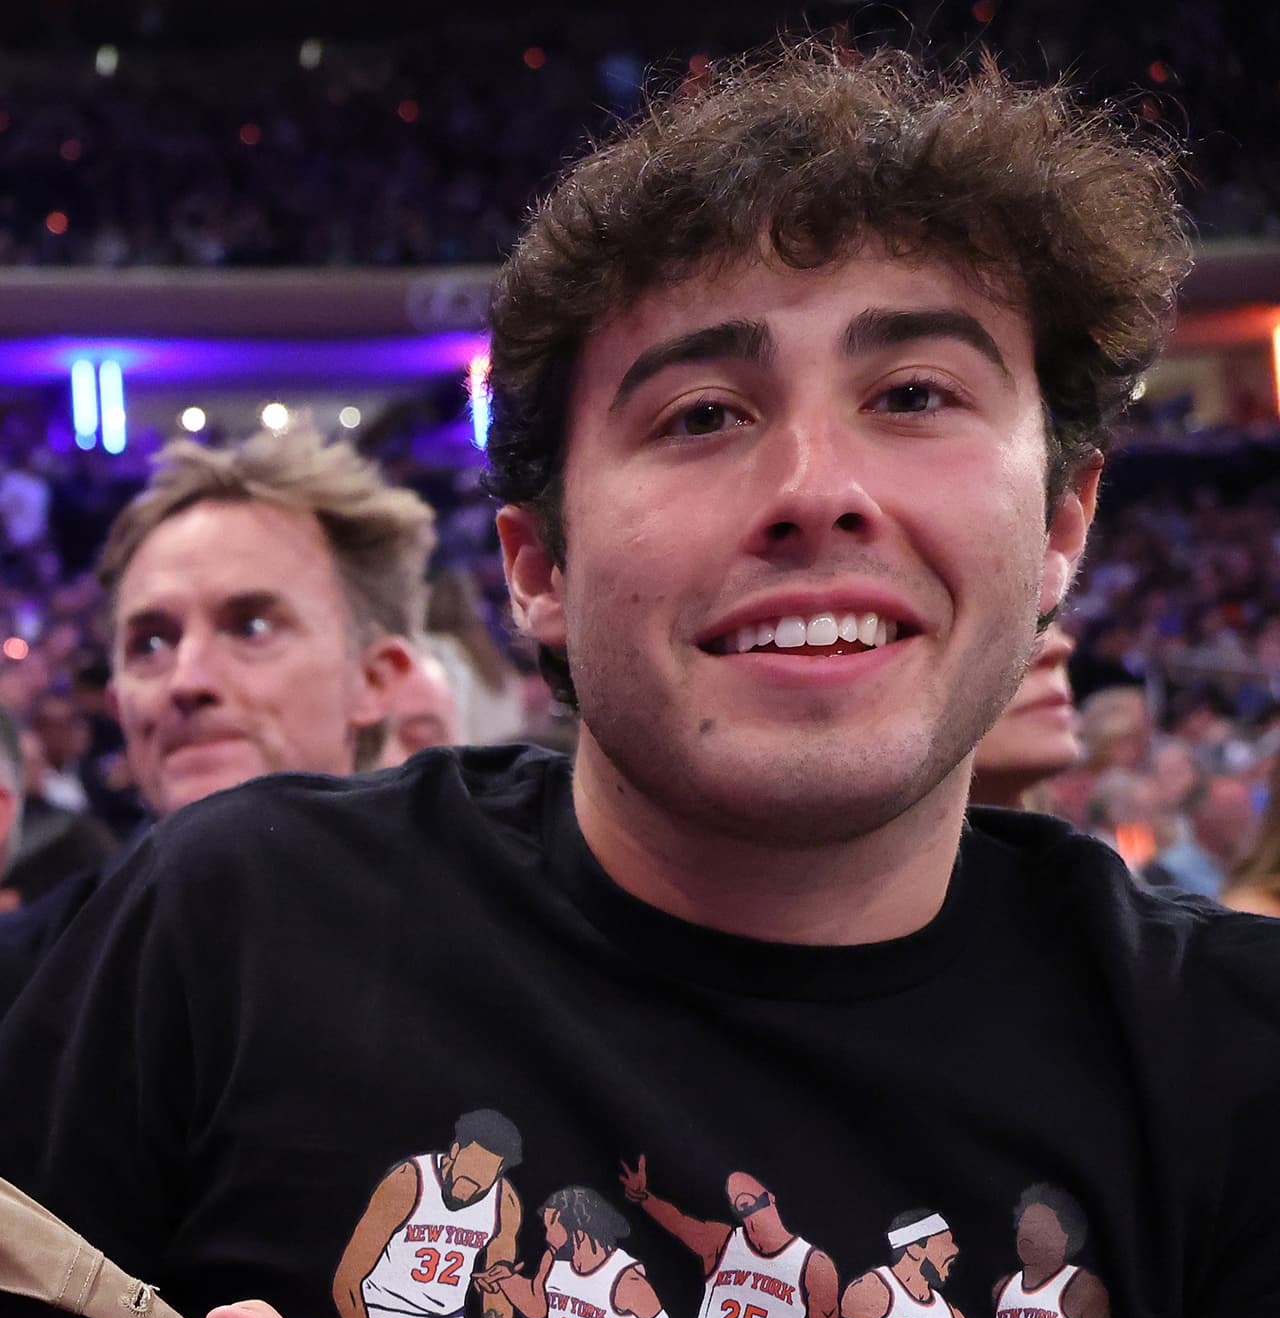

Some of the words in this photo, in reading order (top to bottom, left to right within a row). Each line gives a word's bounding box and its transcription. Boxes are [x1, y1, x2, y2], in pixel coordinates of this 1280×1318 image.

[404, 1224, 444, 1243] NEW
[445, 1225, 489, 1249] YORK
[411, 1248, 465, 1287] 32
[715, 1269, 752, 1286] NEW
[751, 1272, 796, 1305] YORK
